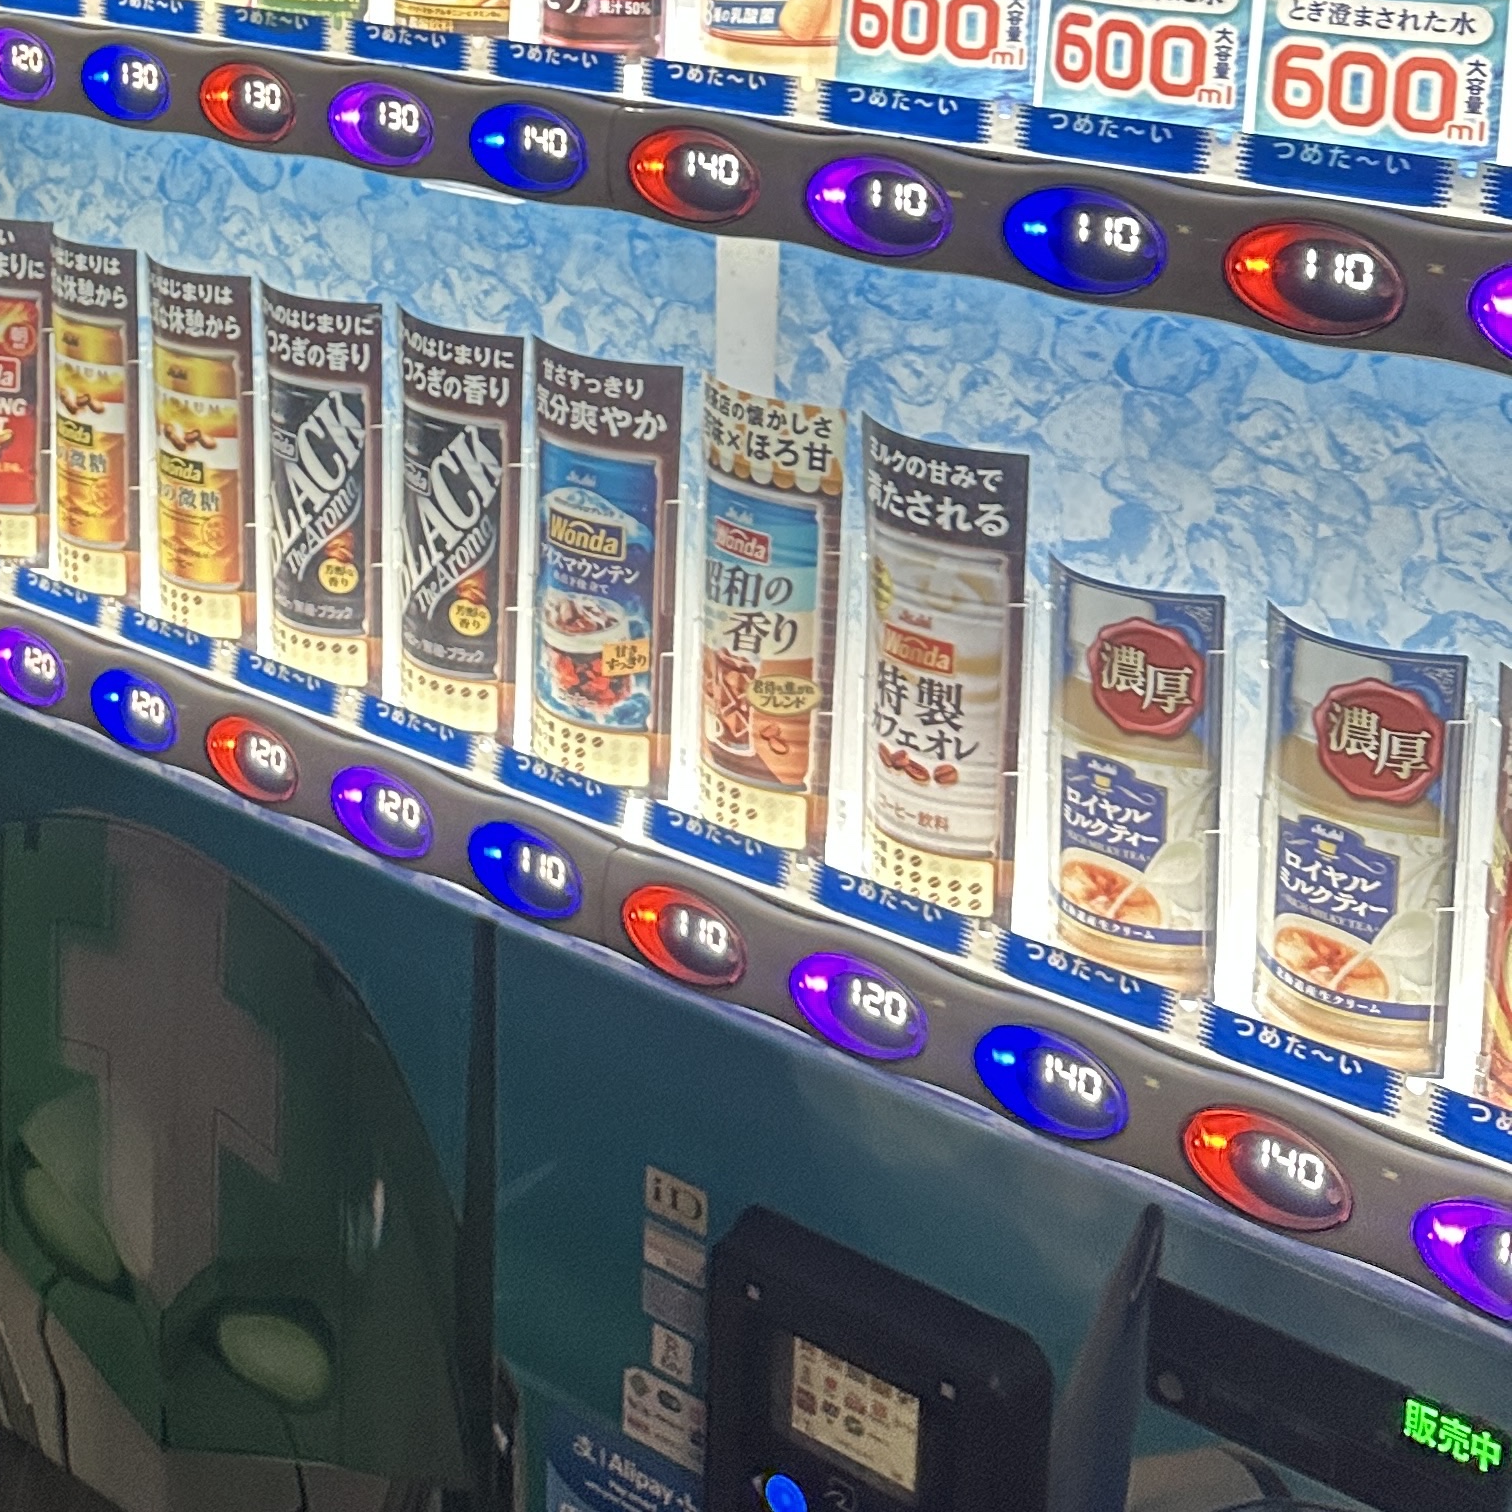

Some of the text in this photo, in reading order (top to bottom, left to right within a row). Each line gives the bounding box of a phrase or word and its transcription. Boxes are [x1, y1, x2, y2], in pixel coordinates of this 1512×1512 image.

[1287, 0, 1478, 36] とぎ澄まされた水
[11, 44, 44, 73] 120
[508, 42, 599, 70] つめた〜い
[1213, 27, 1234, 80] 大容量
[121, 61, 159, 91] 130
[667, 61, 768, 91] つめた〜い
[1463, 59, 1488, 116] 大容量
[244, 81, 282, 113] 130
[379, 101, 420, 134] 130
[846, 86, 959, 115] つめた〜い
[523, 123, 568, 159] 140
[1048, 110, 1174, 145] つめた〜い
[687, 148, 741, 188] 140
[1272, 140, 1412, 175] つめた〜い
[870, 178, 928, 217] 110
[1077, 212, 1141, 252] 110
[1306, 248, 1374, 291] 110
[542, 358, 645, 400] 甘さすっきり
[550, 512, 619, 555] Wonda
[717, 523, 768, 560] Wonda
[726, 610, 798, 657] 香り
[886, 624, 952, 670] Wonda
[24, 645, 56, 680] 120
[1100, 641, 1194, 715] 濃厚
[130, 689, 166, 725] 120
[877, 659, 964, 731] 特製
[377, 701, 455, 741] つめた〜い
[251, 737, 286, 774] 120
[1328, 704, 1433, 780] 濃厚
[515, 756, 603, 796] つめた〜い
[379, 789, 420, 829] 120
[1065, 783, 1154, 824] ロイヤル
[667, 809, 763, 856] つめた〜い
[1063, 804, 1160, 845] ミルクティー
[1282, 847, 1383, 892] ロイヤル
[837, 875, 942, 921] つめた〜い
[1279, 866, 1389, 917] ミルクティー
[1025, 940, 1142, 995] つめた〜い
[850, 978, 907, 1025] 120
[1233, 1015, 1363, 1077] つめた〜い
[1043, 1054, 1103, 1102] 140
[1259, 1138, 1325, 1190] 140
[1402, 1396, 1504, 1472] 販売中
